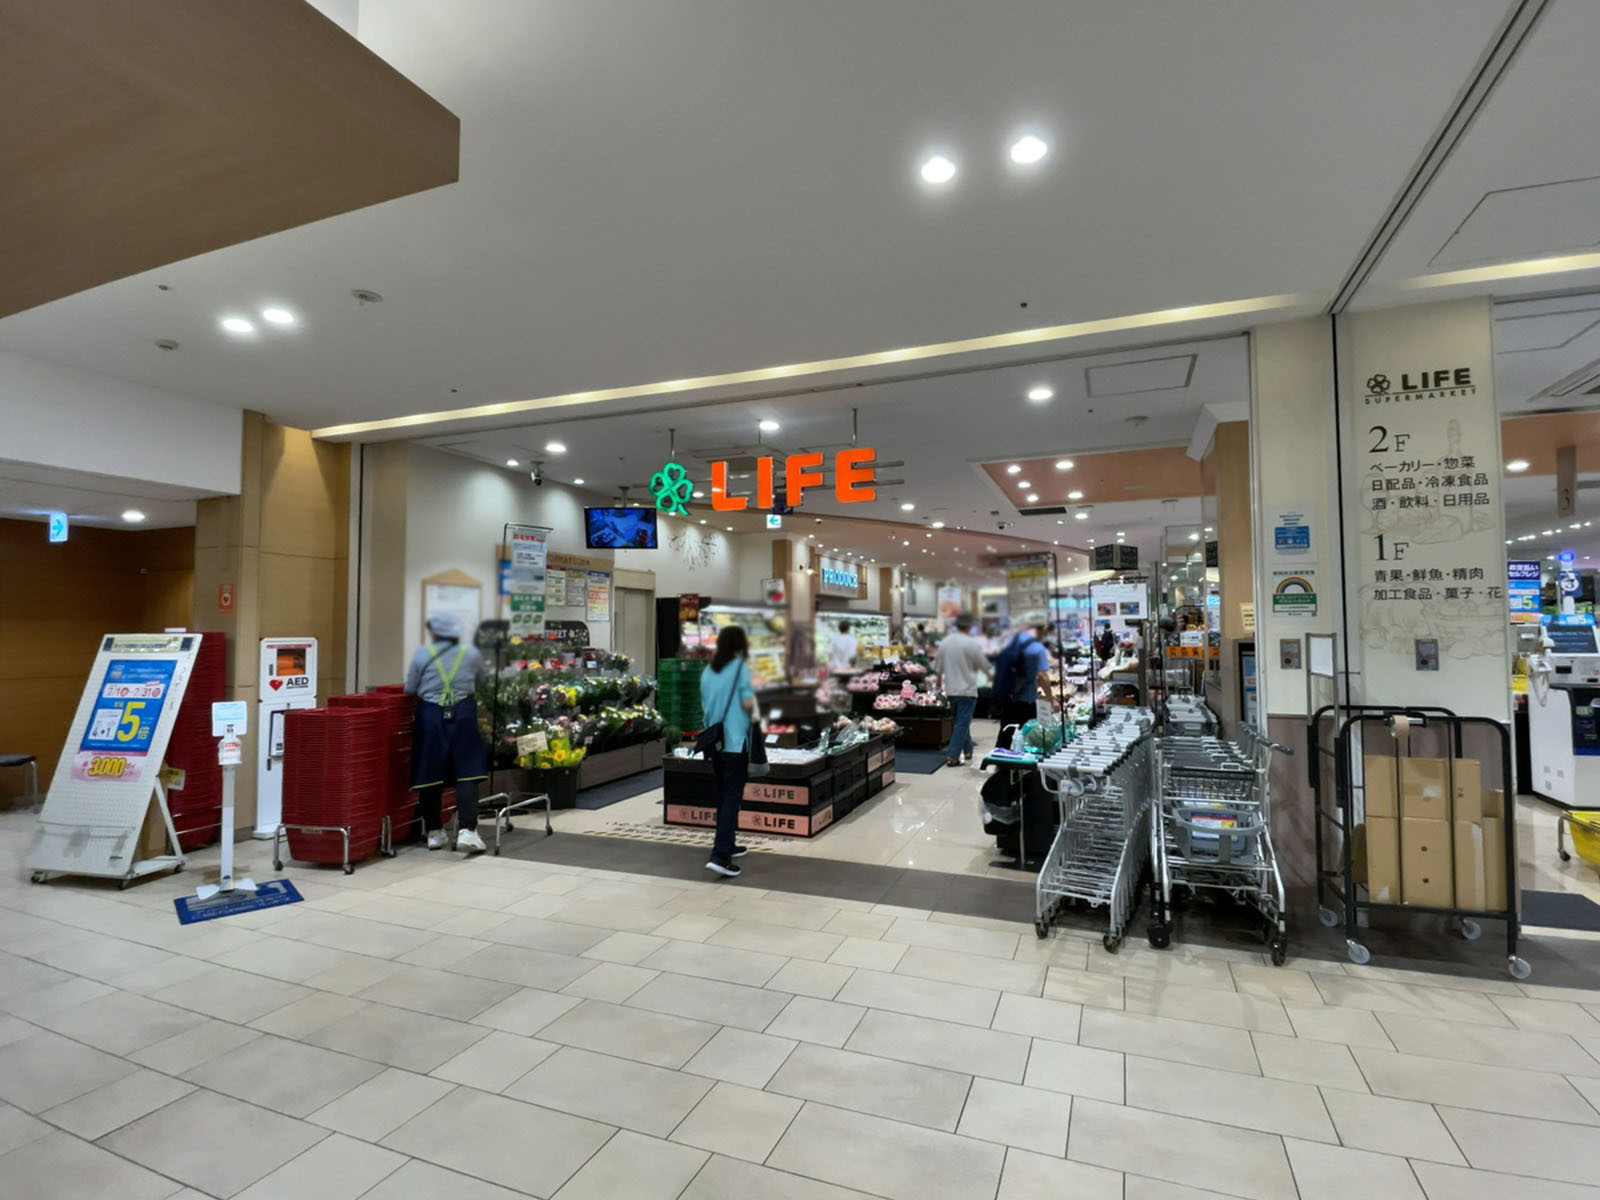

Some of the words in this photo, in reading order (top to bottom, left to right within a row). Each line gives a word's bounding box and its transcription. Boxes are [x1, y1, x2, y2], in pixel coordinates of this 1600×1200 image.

[1401, 368, 1471, 390] LIFE
[1365, 388, 1476, 405] SUPERMARKET
[1369, 425, 1410, 453] 2F
[1370, 456, 1475, 472] ベーカリー・惣菜
[711, 447, 877, 512] LIFE
[1372, 473, 1488, 491] 日配品・冷凍食品
[1371, 492, 1489, 510] 酒・飲料・日用品
[1374, 534, 1409, 560] 1F
[1375, 567, 1484, 582] 青果・鮮魚・精肉
[1374, 586, 1503, 600] 加工食品・菓子・花
[286, 677, 309, 686] AED
[762, 788, 795, 800] LIFE
[764, 815, 796, 829] LIFE
